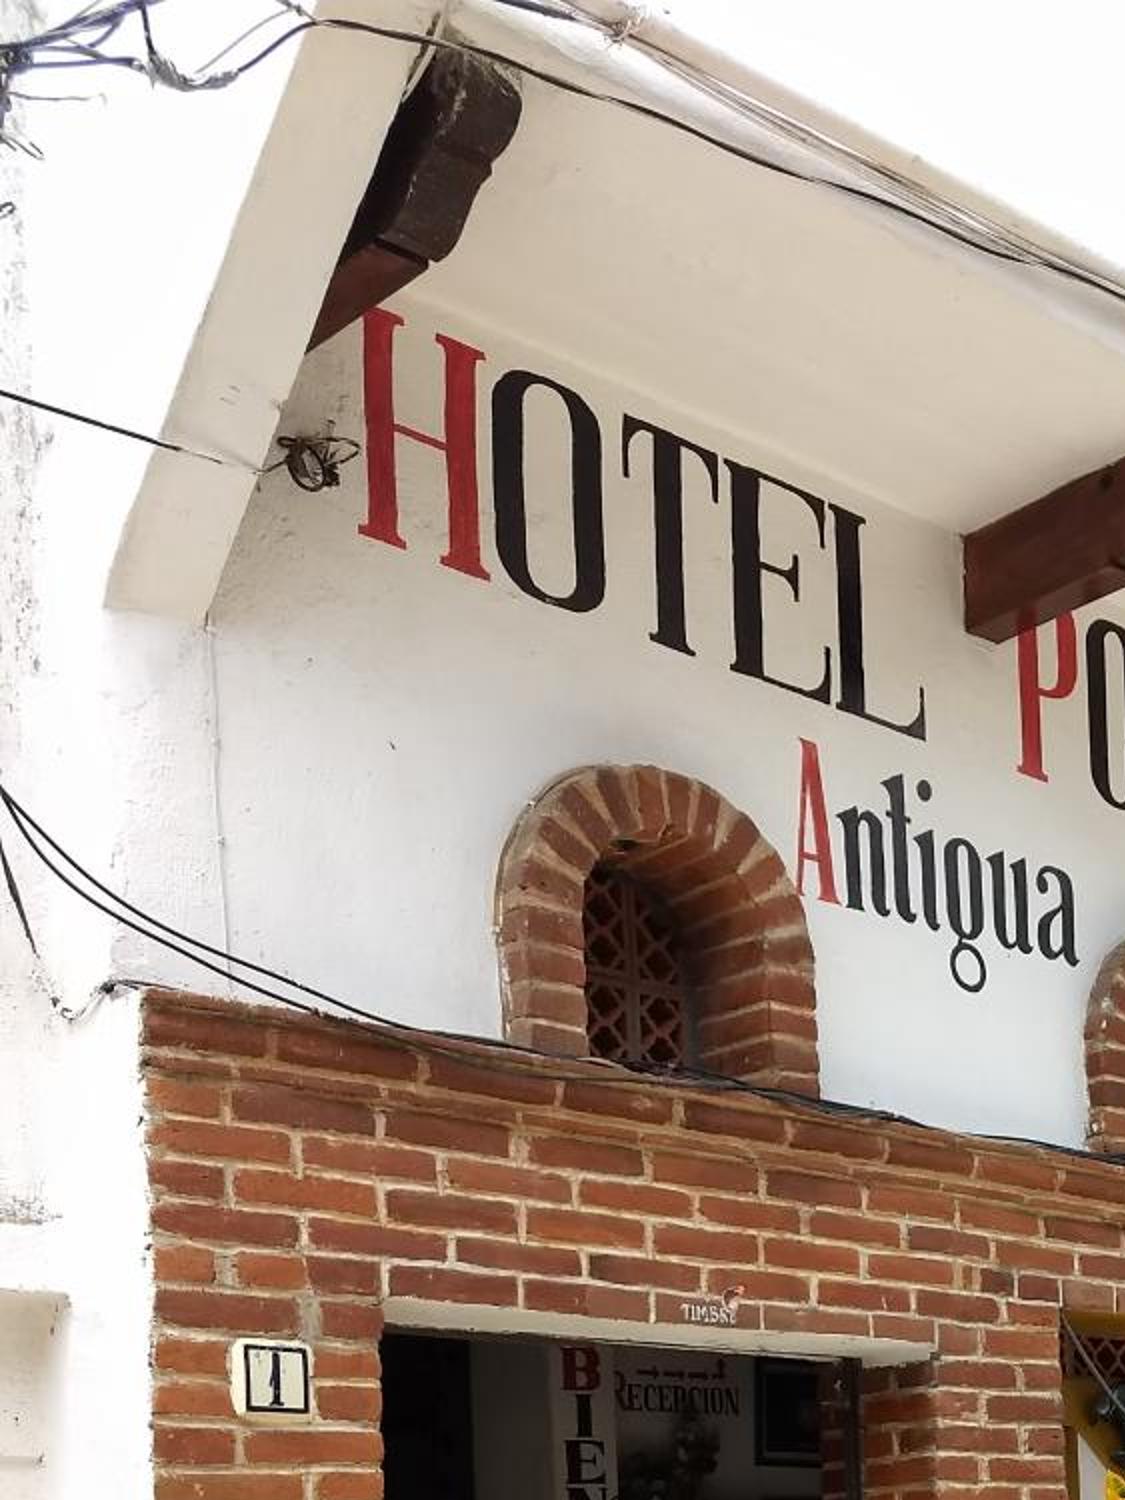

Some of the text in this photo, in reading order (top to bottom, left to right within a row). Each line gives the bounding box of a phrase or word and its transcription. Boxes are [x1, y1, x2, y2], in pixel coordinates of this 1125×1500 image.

[358, 307, 926, 740] HOTEL
[797, 737, 1080, 992] Antigua
[268, 1352, 285, 1407] 1
